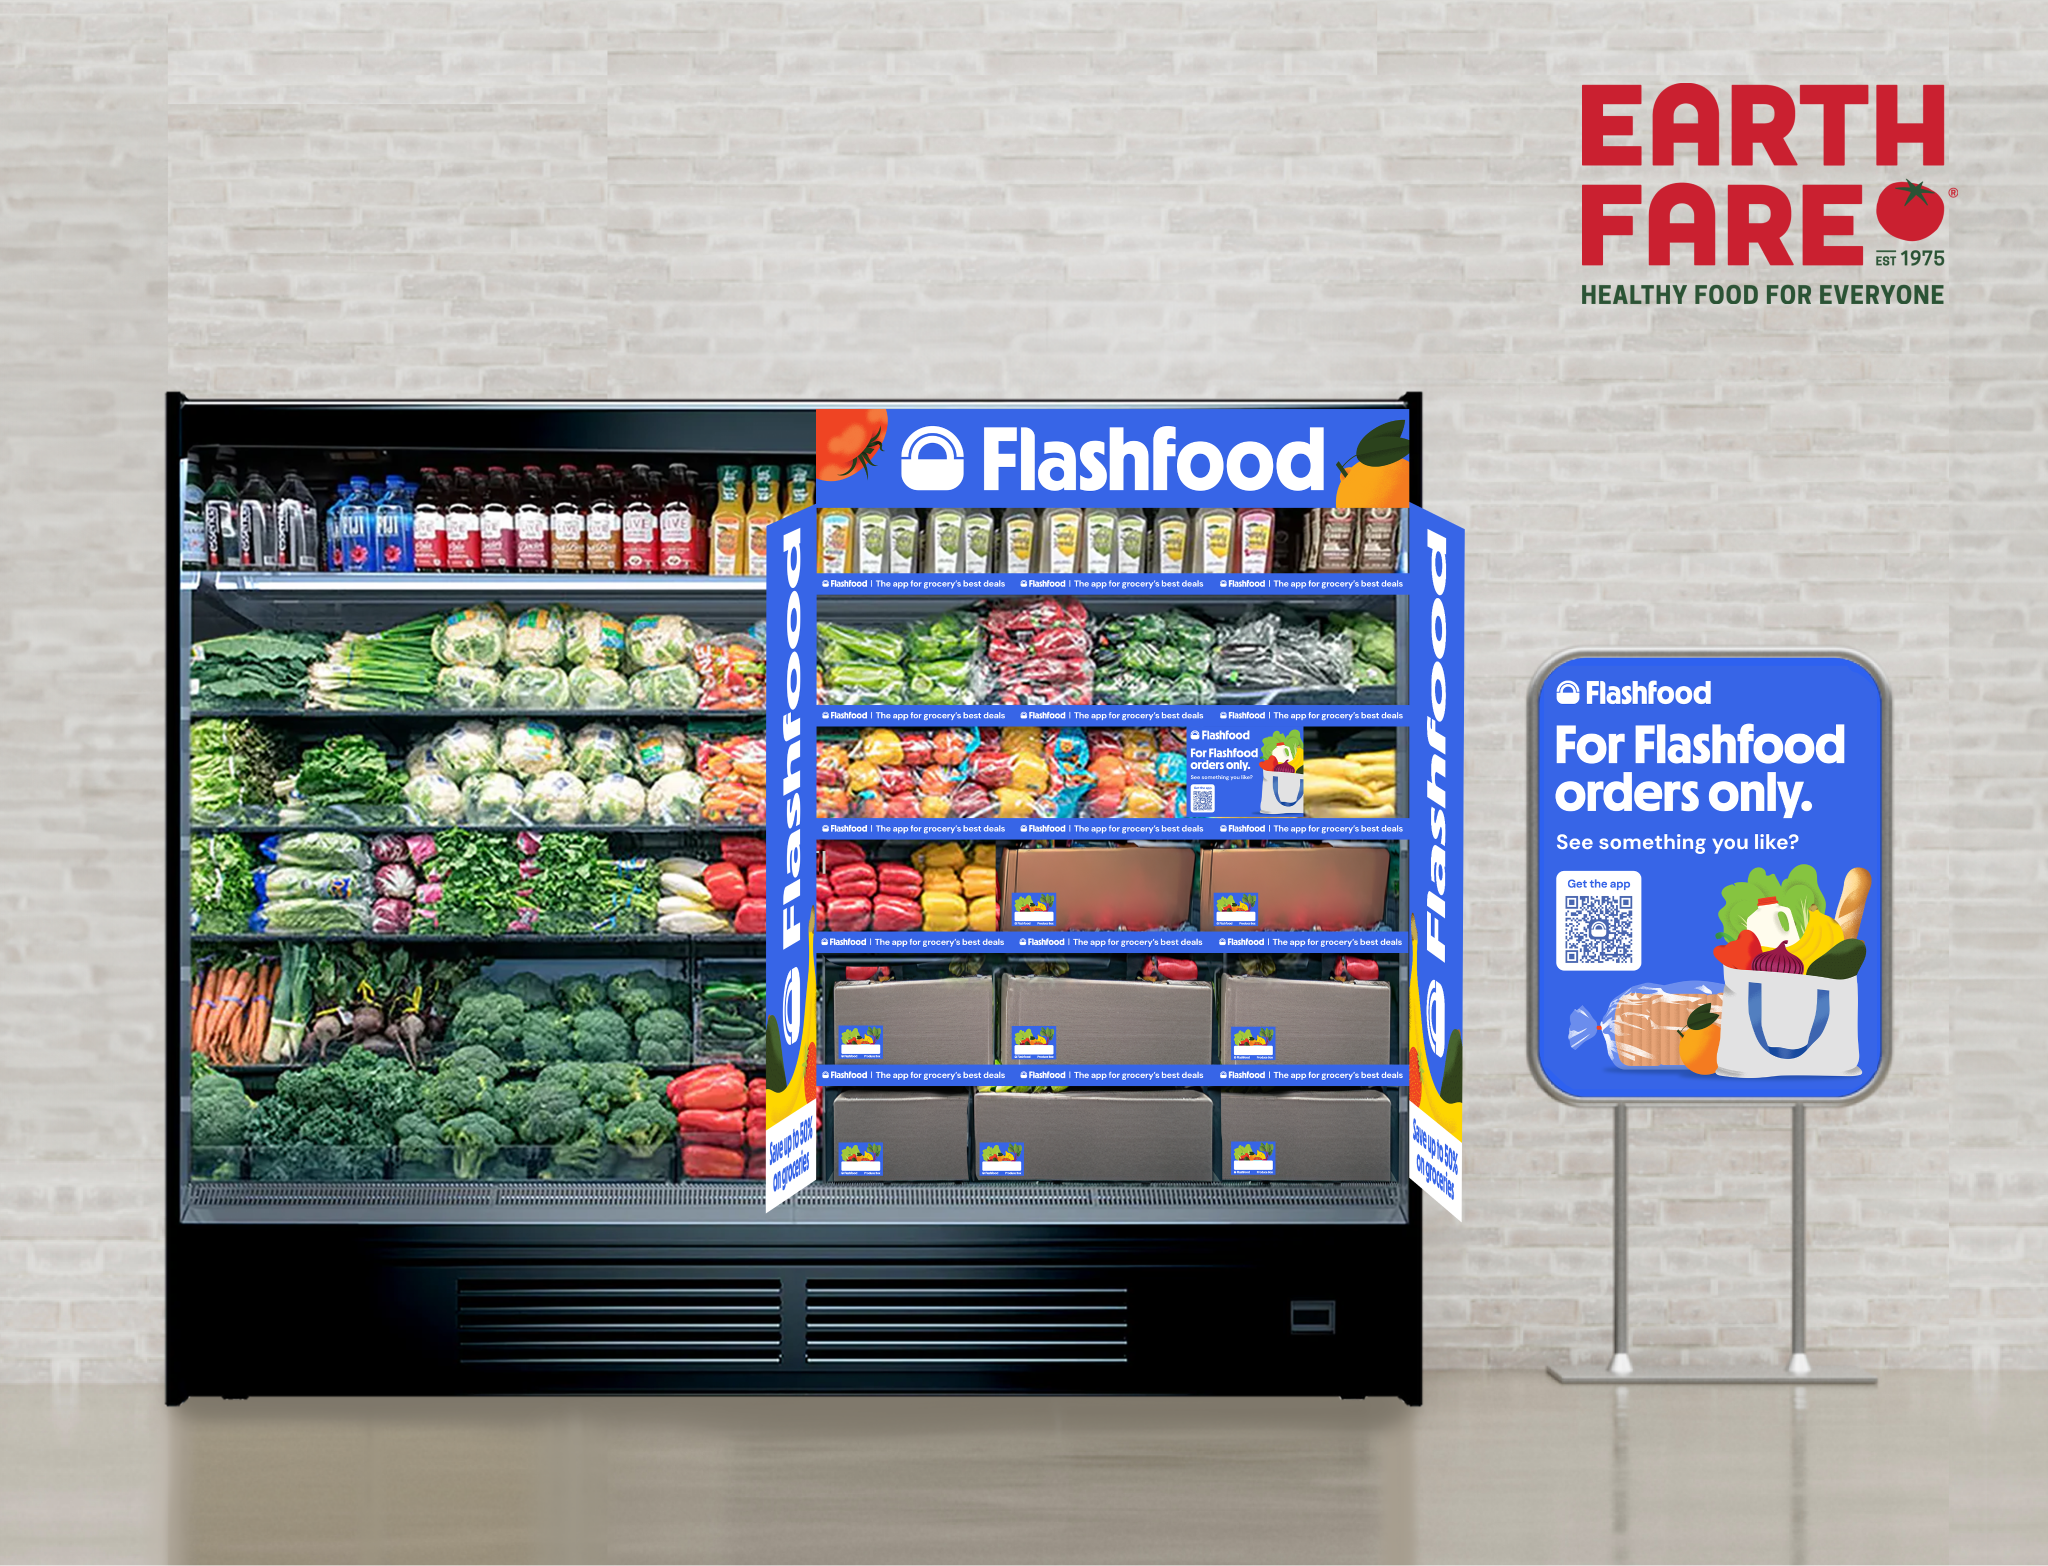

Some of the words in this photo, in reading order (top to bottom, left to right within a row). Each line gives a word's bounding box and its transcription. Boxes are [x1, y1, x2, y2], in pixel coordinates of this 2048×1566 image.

[1582, 83, 1945, 166] EARTH
[1582, 182, 1864, 266] FARE
[1875, 255, 1896, 267] EST
[1900, 249, 1945, 267] 1975
[1581, 284, 1687, 305] HEALTHY
[1694, 284, 1759, 305] FOOD
[1766, 284, 1812, 305] FOR
[1819, 284, 1944, 305] EVERYONE
[984, 425, 1325, 492] Flashfood
[830, 579, 868, 588] Flashfood
[875, 579, 892, 588] The
[892, 581, 909, 590] app
[909, 579, 923, 588] for
[962, 579, 982, 588] best
[982, 579, 1006, 588] deals
[1028, 579, 1066, 588] Flashfood
[1073, 579, 1090, 588] The
[1090, 581, 1107, 590] app
[1107, 579, 1121, 588] for
[1160, 579, 1180, 588] best
[1180, 579, 1204, 588] deals
[1228, 579, 1266, 588] Flashfood
[1273, 579, 1290, 588] The
[1290, 581, 1307, 590] app
[1307, 579, 1321, 588] for
[1360, 579, 1380, 588] best
[1380, 579, 1404, 588] deals
[1586, 679, 1712, 705] Flashfood
[830, 711, 868, 720] Flashfood
[875, 711, 892, 720] The
[892, 713, 909, 722] app
[909, 711, 923, 720] for
[962, 711, 982, 720] best
[982, 711, 1006, 720] deals
[1028, 711, 1066, 720] Flashfood
[1073, 711, 1090, 720] The
[1090, 713, 1107, 722] app
[1107, 711, 1121, 720] for
[1160, 711, 1180, 720] best
[1180, 711, 1204, 720] deals
[1228, 711, 1266, 720] Flashfood
[1273, 711, 1290, 720] The
[1290, 713, 1307, 722] app
[1307, 711, 1321, 720] for
[1360, 711, 1380, 720] best
[1380, 711, 1404, 720] deals
[782, 528, 801, 950] Flashfood
[1201, 729, 1251, 740] Flashfood
[1426, 529, 1447, 963] Flashfood
[1555, 724, 1626, 765] For
[1634, 722, 1846, 765] Flashfood
[1190, 747, 1208, 758] For
[1208, 747, 1259, 758] Flashfood
[1190, 759, 1225, 770] orders
[1225, 759, 1251, 772] only.
[1554, 771, 1700, 812] orders
[1708, 771, 1813, 819] only.
[830, 824, 868, 833] Flashfood
[875, 824, 892, 833] The
[892, 826, 909, 835] app
[909, 824, 923, 833] for
[962, 824, 982, 833] best
[982, 824, 1006, 833] deals
[1028, 824, 1066, 833] Flashfood
[1073, 824, 1090, 833] The
[1090, 826, 1107, 835] app
[1107, 824, 1121, 833] for
[1160, 824, 1180, 833] best
[1180, 824, 1204, 833] deals
[1228, 824, 1266, 833] Flashfood
[1273, 824, 1290, 833] The
[1290, 826, 1307, 835] app
[1307, 824, 1321, 833] for
[1360, 824, 1380, 833] best
[1380, 824, 1404, 833] deals
[1556, 833, 1594, 851] See
[1598, 833, 1707, 855] something
[1711, 837, 1749, 855] you
[1754, 833, 1800, 851] like?
[1567, 878, 1588, 890] Get
[1588, 878, 1608, 890] the
[1609, 881, 1631, 893] app
[829, 937, 867, 946] Flashfood
[874, 937, 891, 946] The
[891, 939, 908, 948] app
[908, 937, 922, 946] for
[961, 937, 981, 946] best
[981, 937, 1005, 946] deals
[1227, 937, 1265, 946] Flashfood
[1272, 937, 1289, 946] The
[1289, 939, 1306, 948] app
[1306, 937, 1320, 946] for
[1359, 937, 1379, 946] best
[1379, 937, 1403, 946] deals
[830, 1070, 868, 1079] Flashfood
[875, 1070, 892, 1079] The
[892, 1072, 909, 1081] app
[909, 1070, 923, 1079] for
[962, 1070, 982, 1079] best
[982, 1070, 1006, 1079] deals
[1028, 1070, 1066, 1079] Flashfood
[1073, 1070, 1090, 1079] The
[1090, 1072, 1107, 1081] app
[1107, 1070, 1121, 1079] for
[1160, 1070, 1180, 1079] best
[1180, 1070, 1204, 1079] deals
[1228, 1070, 1266, 1079] Flashfood
[1273, 1070, 1290, 1079] The
[1290, 1072, 1307, 1081] app
[1307, 1070, 1321, 1079] for
[1360, 1070, 1380, 1079] best
[1380, 1070, 1404, 1079] deals
[769, 1141, 784, 1166] Save
[783, 1134, 792, 1158] up
[792, 1128, 800, 1151] to
[800, 1115, 814, 1146] 50%
[1412, 1117, 1428, 1150] Save
[1427, 1134, 1436, 1160] up
[1436, 1138, 1444, 1163] to
[1444, 1143, 1459, 1175] 50%
[772, 1170, 782, 1193] on
[782, 1149, 810, 1191] groceries
[1416, 1153, 1425, 1176] on
[1425, 1161, 1455, 1201] groceries
